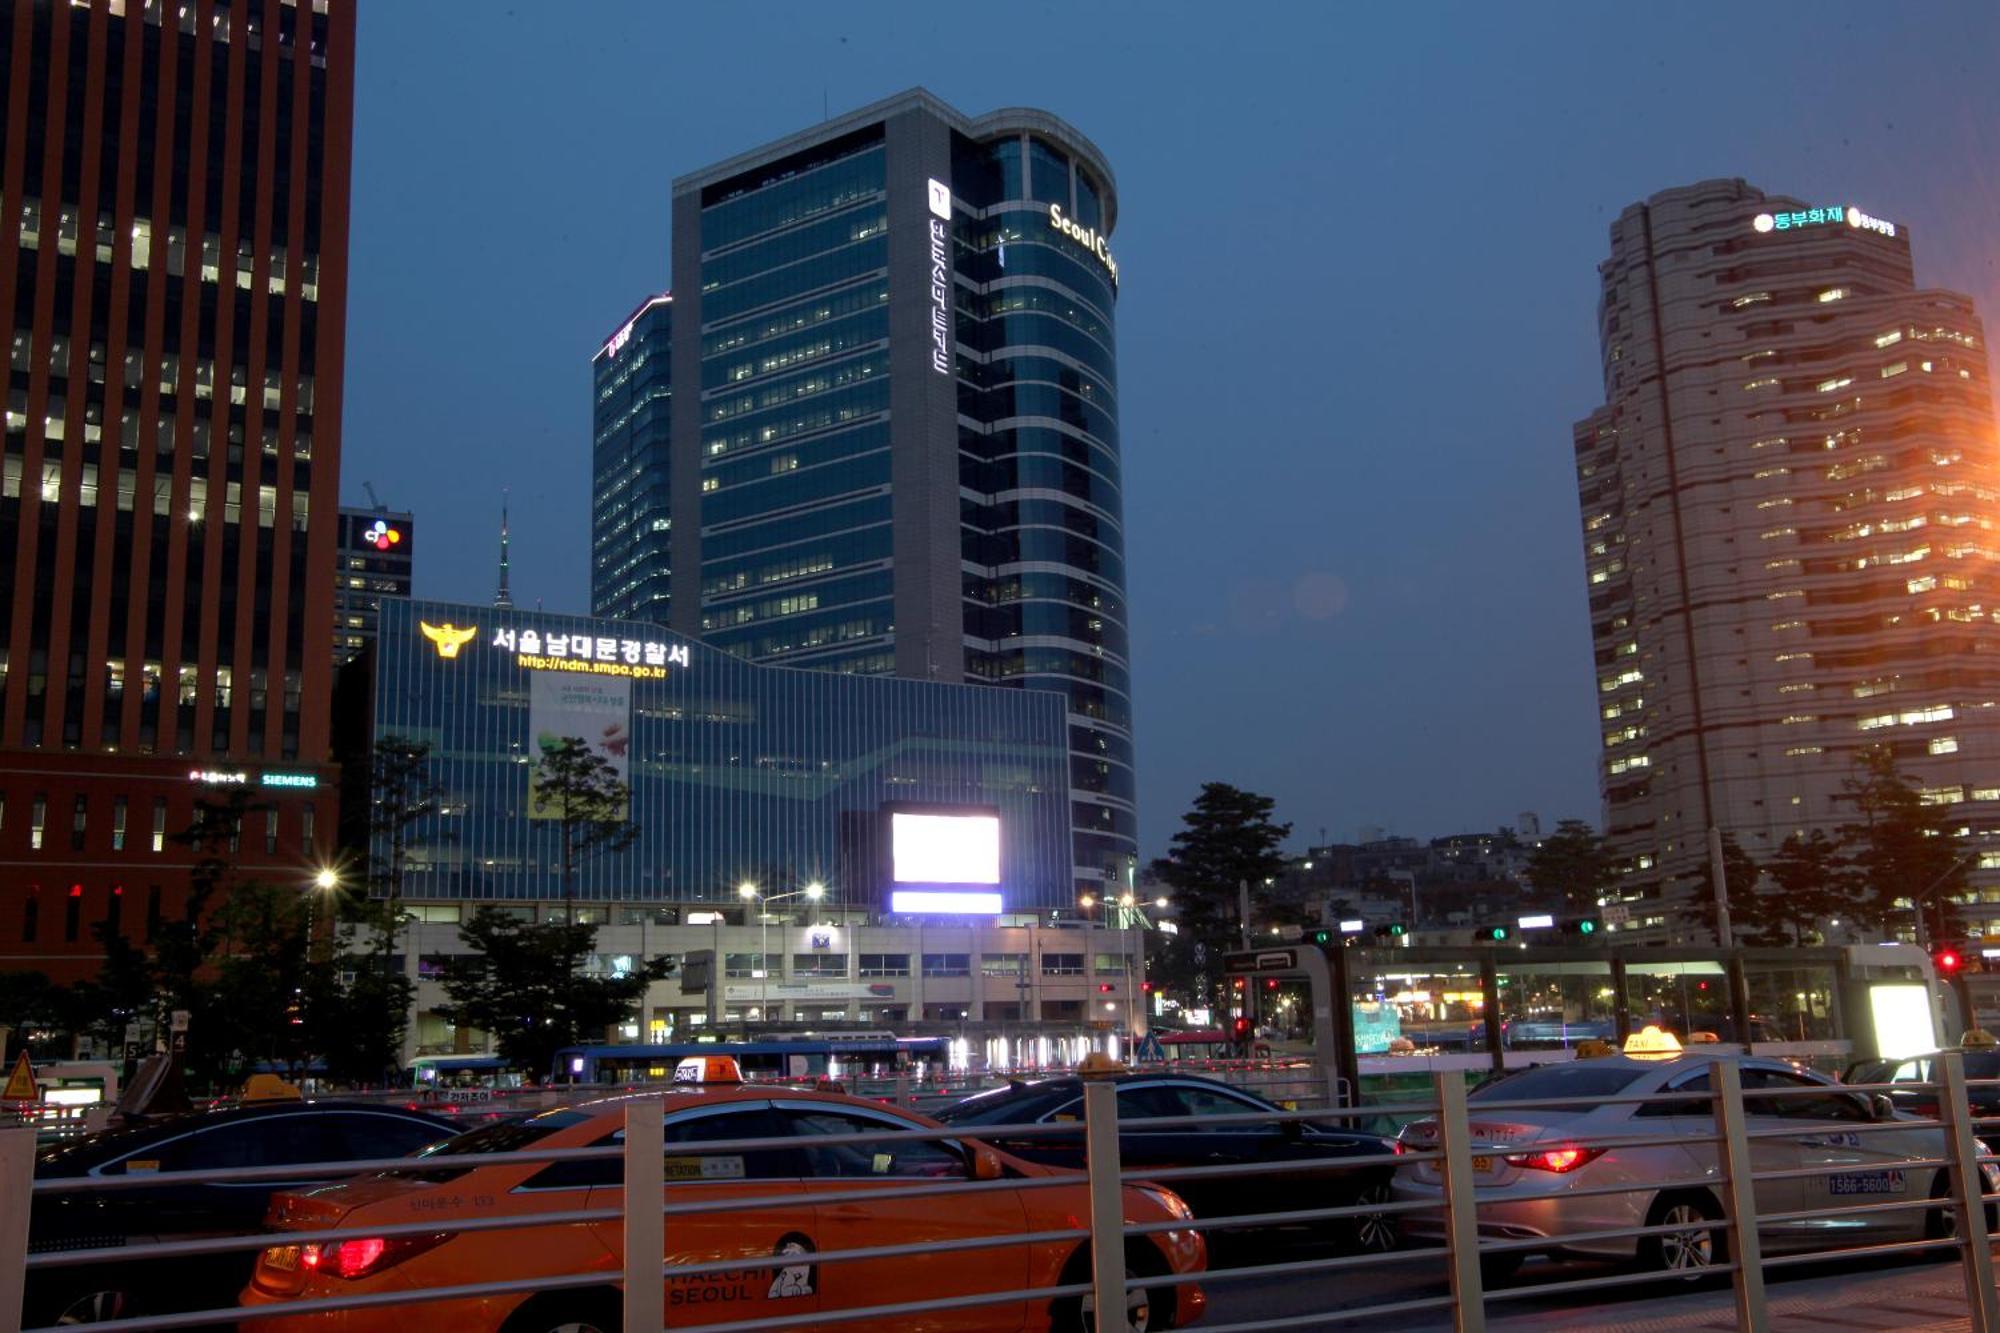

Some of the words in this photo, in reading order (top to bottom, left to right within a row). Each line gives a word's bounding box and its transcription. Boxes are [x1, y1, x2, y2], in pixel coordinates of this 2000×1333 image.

[1050, 203, 1096, 252] Seoul
[1774, 205, 1844, 230] 동부화재
[492, 627, 689, 667] 서울남대문경찰서
[518, 656, 668, 679] http://ndm.smpa.go.kr
[261, 774, 317, 787] SIEMENS
[174, 1035, 185, 1048] 4
[671, 1284, 753, 1305] SEOUL
